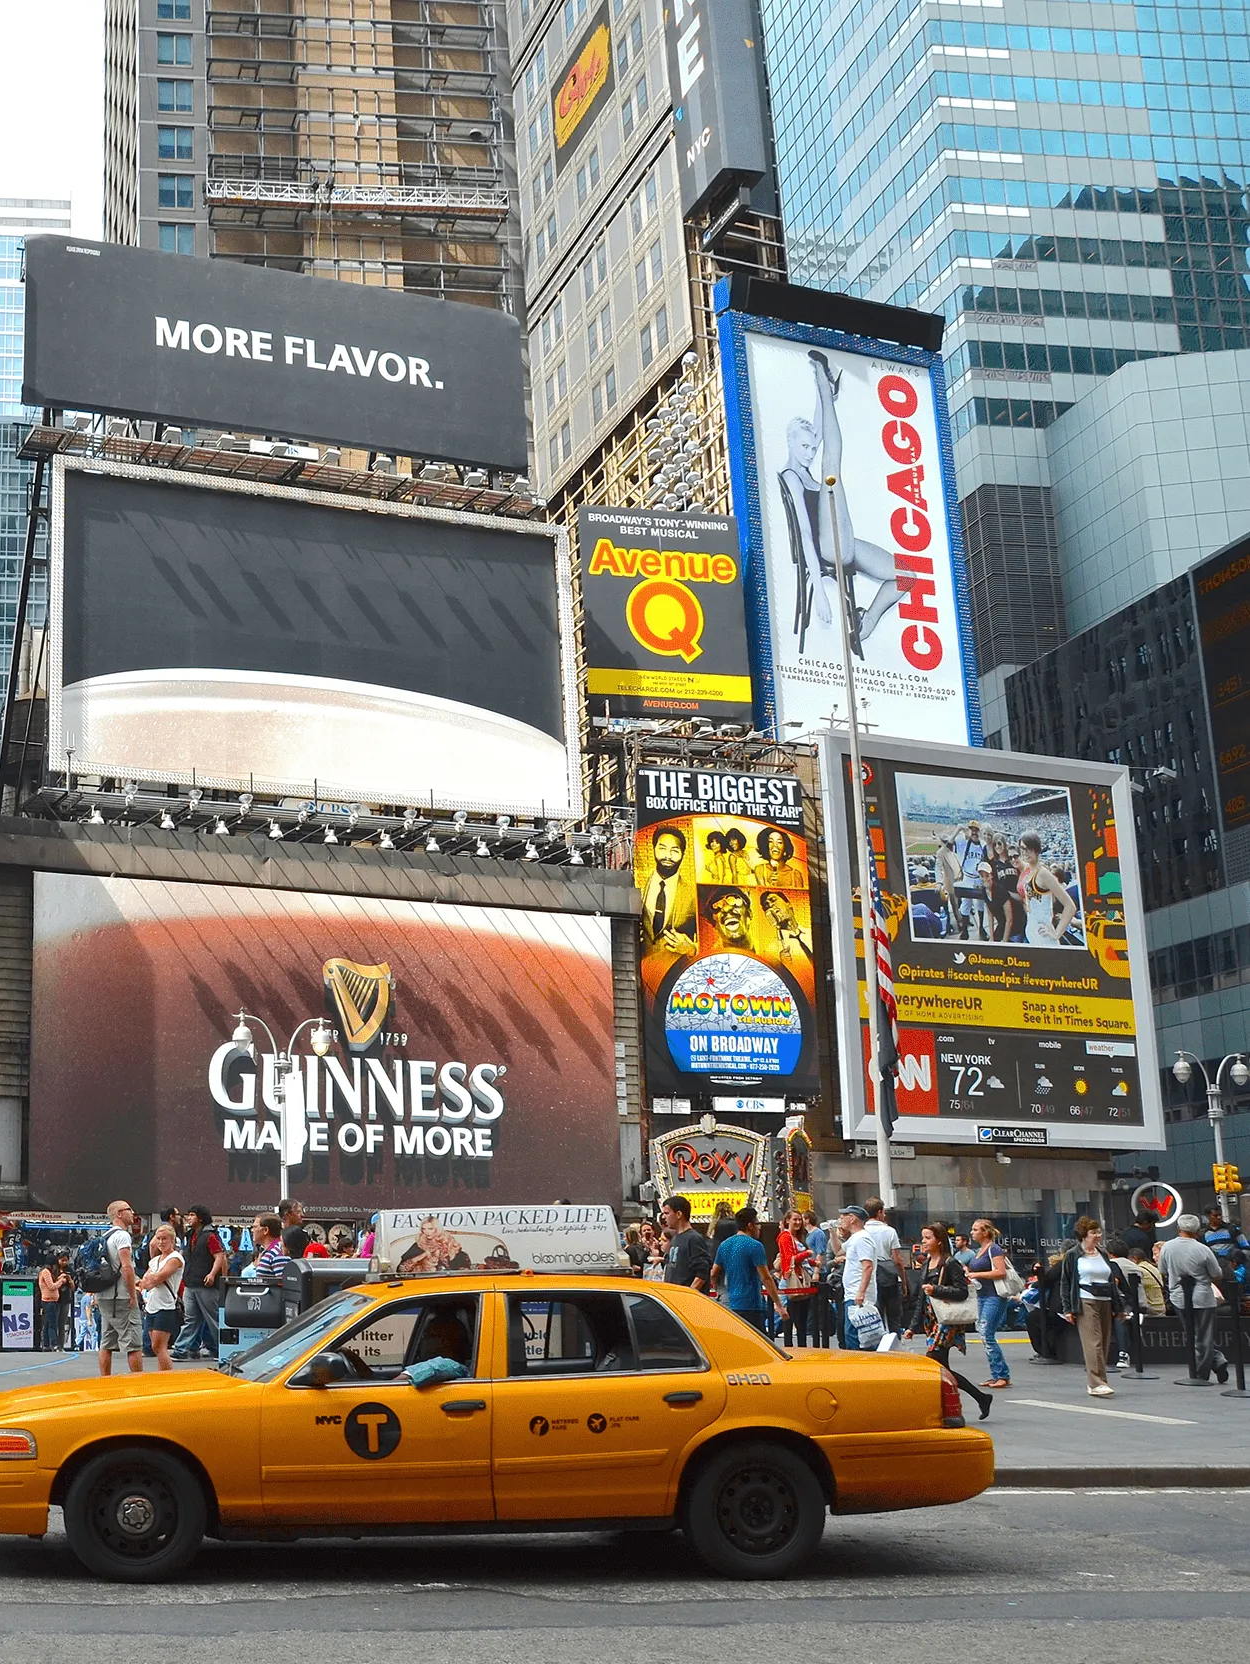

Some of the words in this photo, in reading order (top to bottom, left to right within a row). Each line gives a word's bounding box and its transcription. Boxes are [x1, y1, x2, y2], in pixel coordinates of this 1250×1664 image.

[686, 126, 711, 168] NYC
[154, 316, 274, 362] MORE
[284, 335, 445, 390] FLAVOR.
[871, 362, 920, 378] ALWAYS
[588, 512, 652, 526] BROADWAY'S
[877, 374, 943, 671] CHICAGO
[620, 525, 648, 536] BEST
[651, 528, 699, 539] MUSICAL
[590, 539, 736, 583] Avenue
[627, 578, 703, 663] Q
[617, 685, 675, 694] TELECHARGE.COM
[787, 675, 831, 686] AMBASSADOR
[882, 689, 903, 697] STREET
[914, 693, 948, 702] BROADWAY
[900, 683, 956, 697] 212-239-6200
[643, 699, 700, 710] AVENUEQ.COM
[697, 774, 798, 806] BIGGEST
[646, 796, 670, 810] BOX
[670, 798, 707, 812] OFFICE
[710, 801, 727, 813] HIT
[729, 802, 743, 815] OF
[743, 803, 767, 816] THE
[898, 963, 945, 981] @pirates
[947, 967, 1021, 988] #scoreboardpix
[1023, 974, 1098, 992] #everywhereUR
[669, 991, 791, 1018] MOTOWN
[895, 994, 983, 1011] verywhereUR
[1022, 1000, 1047, 1013] Snap
[1058, 1003, 1082, 1014] shot.
[754, 1017, 793, 1026] MUSICAL
[1023, 1012, 1041, 1024] See
[1044, 1013, 1051, 1024] it
[1053, 1014, 1062, 1025] in
[1065, 1016, 1093, 1027] Times
[1096, 1018, 1132, 1030] Square.
[380, 1032, 408, 1046] 1759
[690, 1035, 708, 1052] ON
[711, 1035, 779, 1054] BROADWAY
[1038, 1041, 1062, 1049] mobile
[1088, 1043, 1114, 1052] weather
[940, 1053, 962, 1064] NEW
[964, 1055, 992, 1065] YORK
[949, 1066, 984, 1096] 72
[746, 1100, 765, 1109] CBS
[222, 1119, 330, 1154] MAE
[337, 1121, 386, 1155] OF
[393, 1124, 494, 1161] MORE
[668, 1143, 753, 1181] ROXY
[1140, 1195, 1174, 1217] W
[482, 1209, 559, 1226] PACKED
[564, 1207, 607, 1223] LIFE
[1012, 1238, 1026, 1247] FIN
[361, 1330, 394, 1342] litter
[364, 1345, 381, 1357] its
[315, 1415, 342, 1425] NYC
[356, 1413, 390, 1453] T
